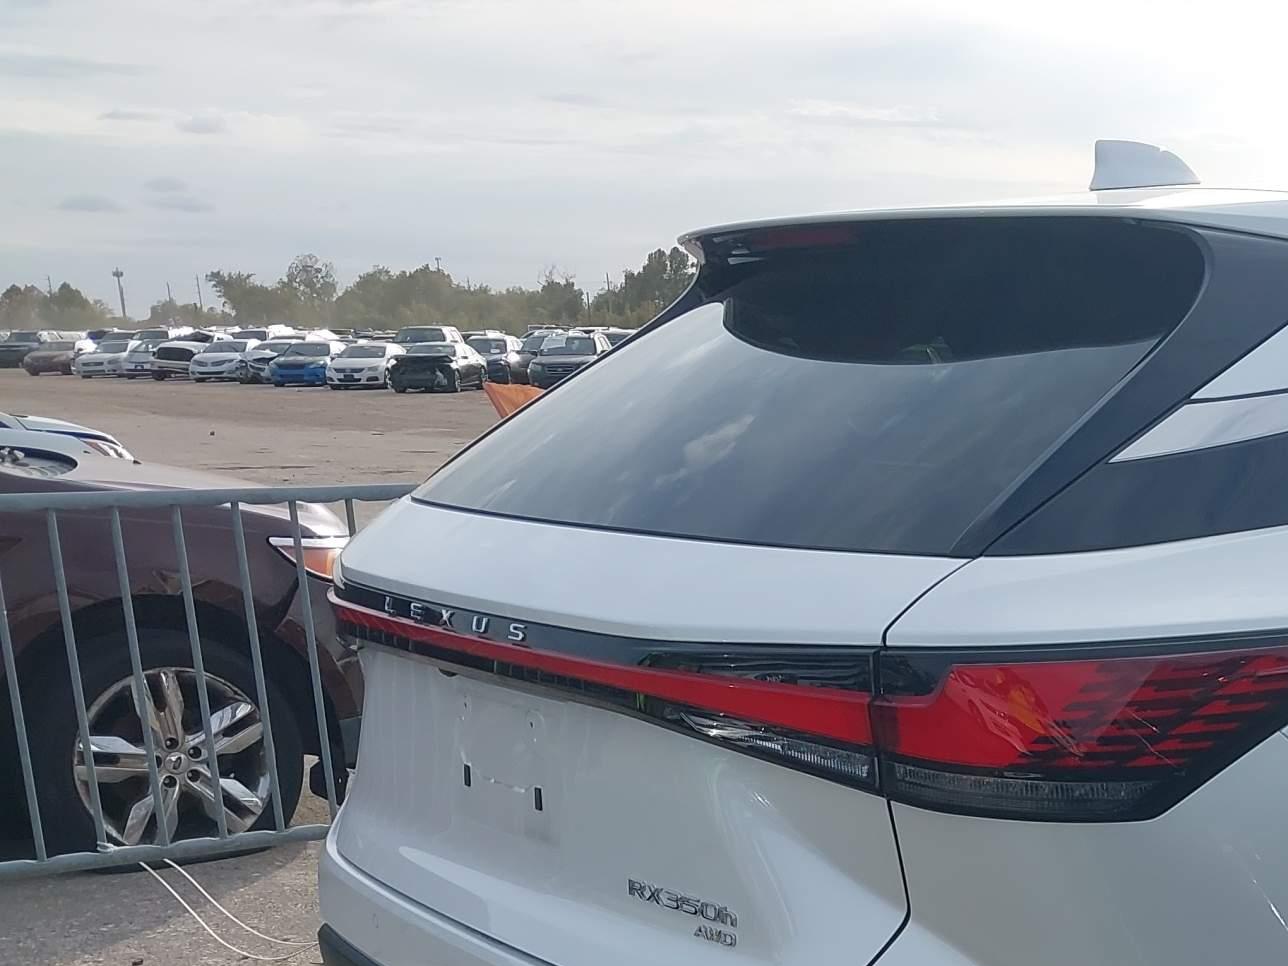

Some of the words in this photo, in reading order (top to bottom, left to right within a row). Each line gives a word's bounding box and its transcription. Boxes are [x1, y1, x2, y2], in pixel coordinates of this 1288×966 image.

[383, 595, 527, 641] LEXUS
[628, 878, 738, 928] RX350h
[693, 924, 737, 948] AWD
